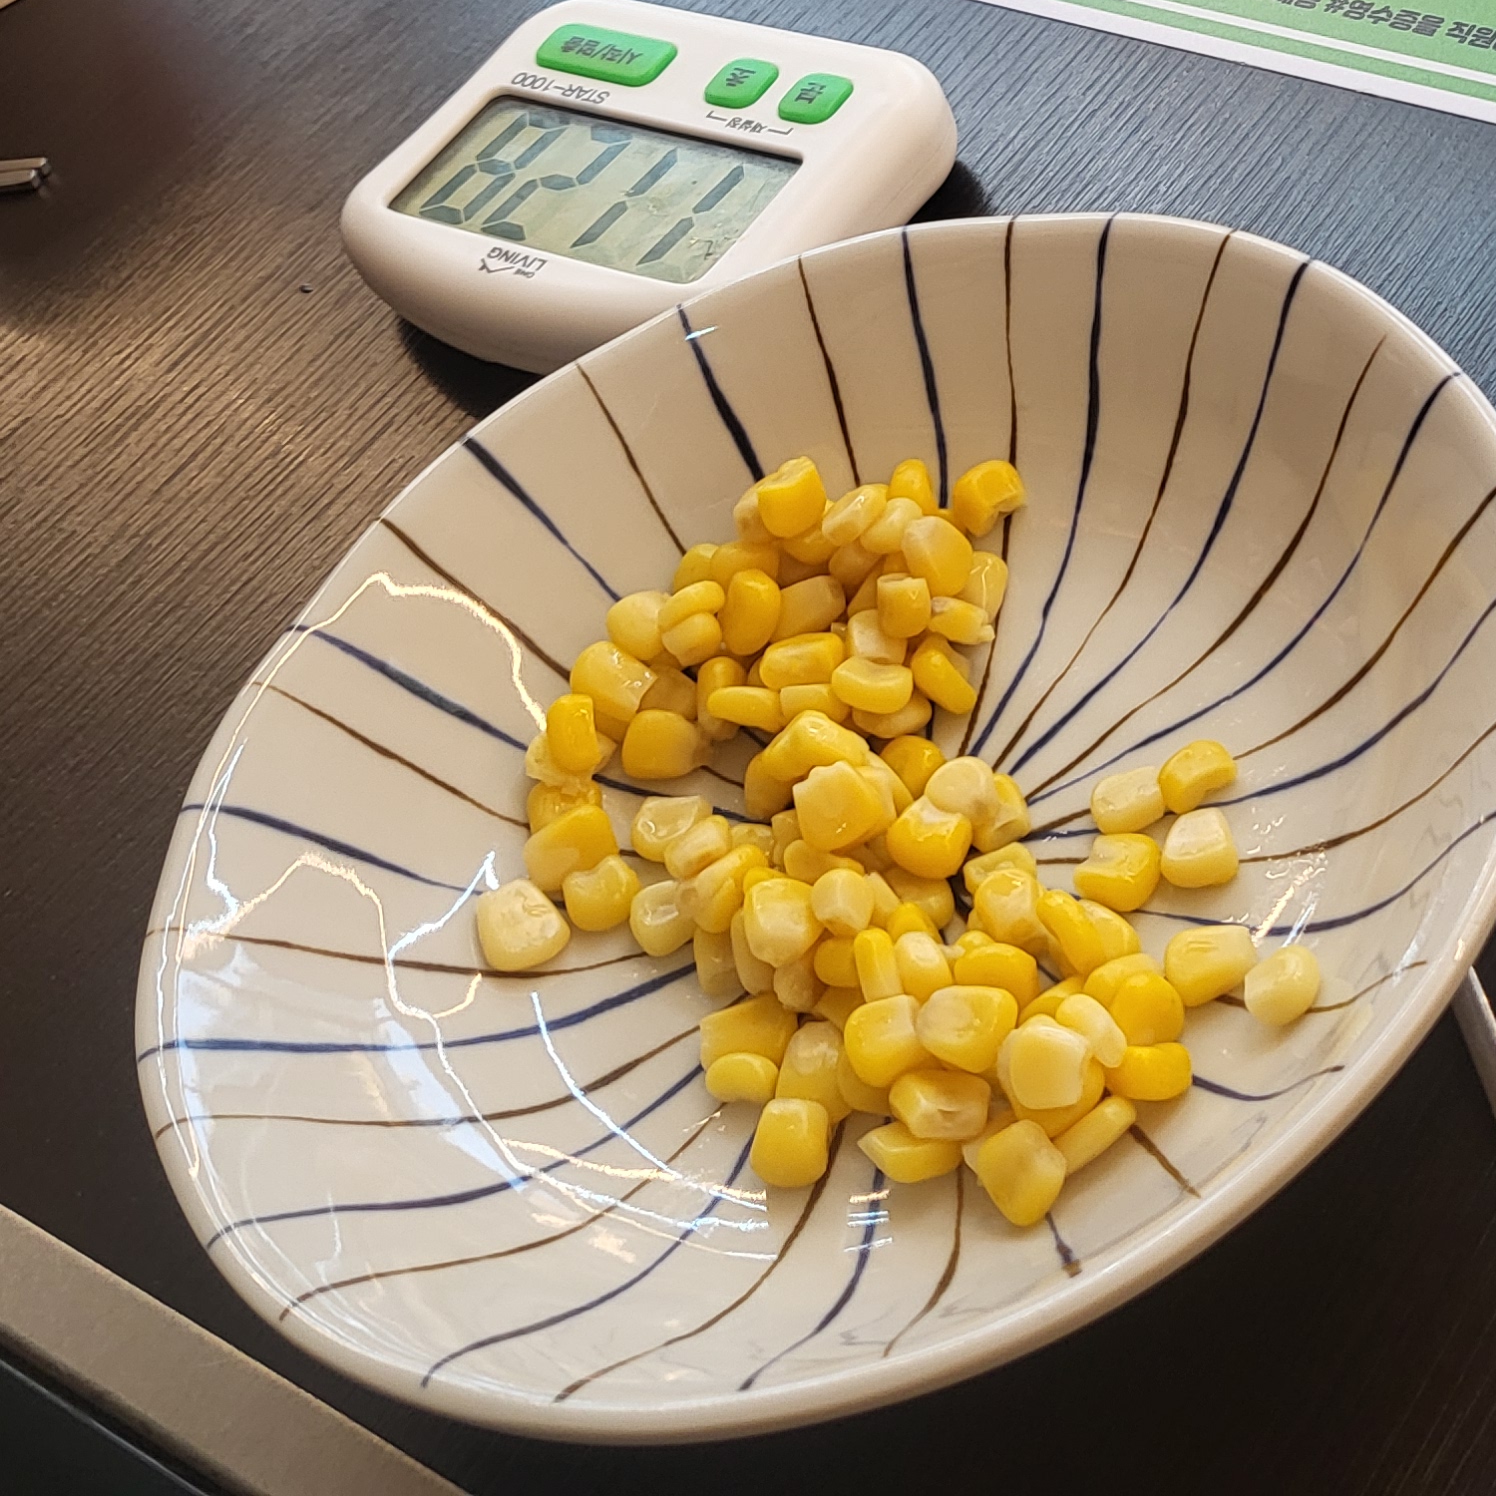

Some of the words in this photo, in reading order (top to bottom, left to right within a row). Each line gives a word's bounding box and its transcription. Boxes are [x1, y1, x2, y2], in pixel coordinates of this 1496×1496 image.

[560, 36, 644, 65] 시작/멈춤
[510, 72, 610, 105] STAR-1000
[726, 66, 756, 87] 초
[487, 246, 548, 272] LIVING
